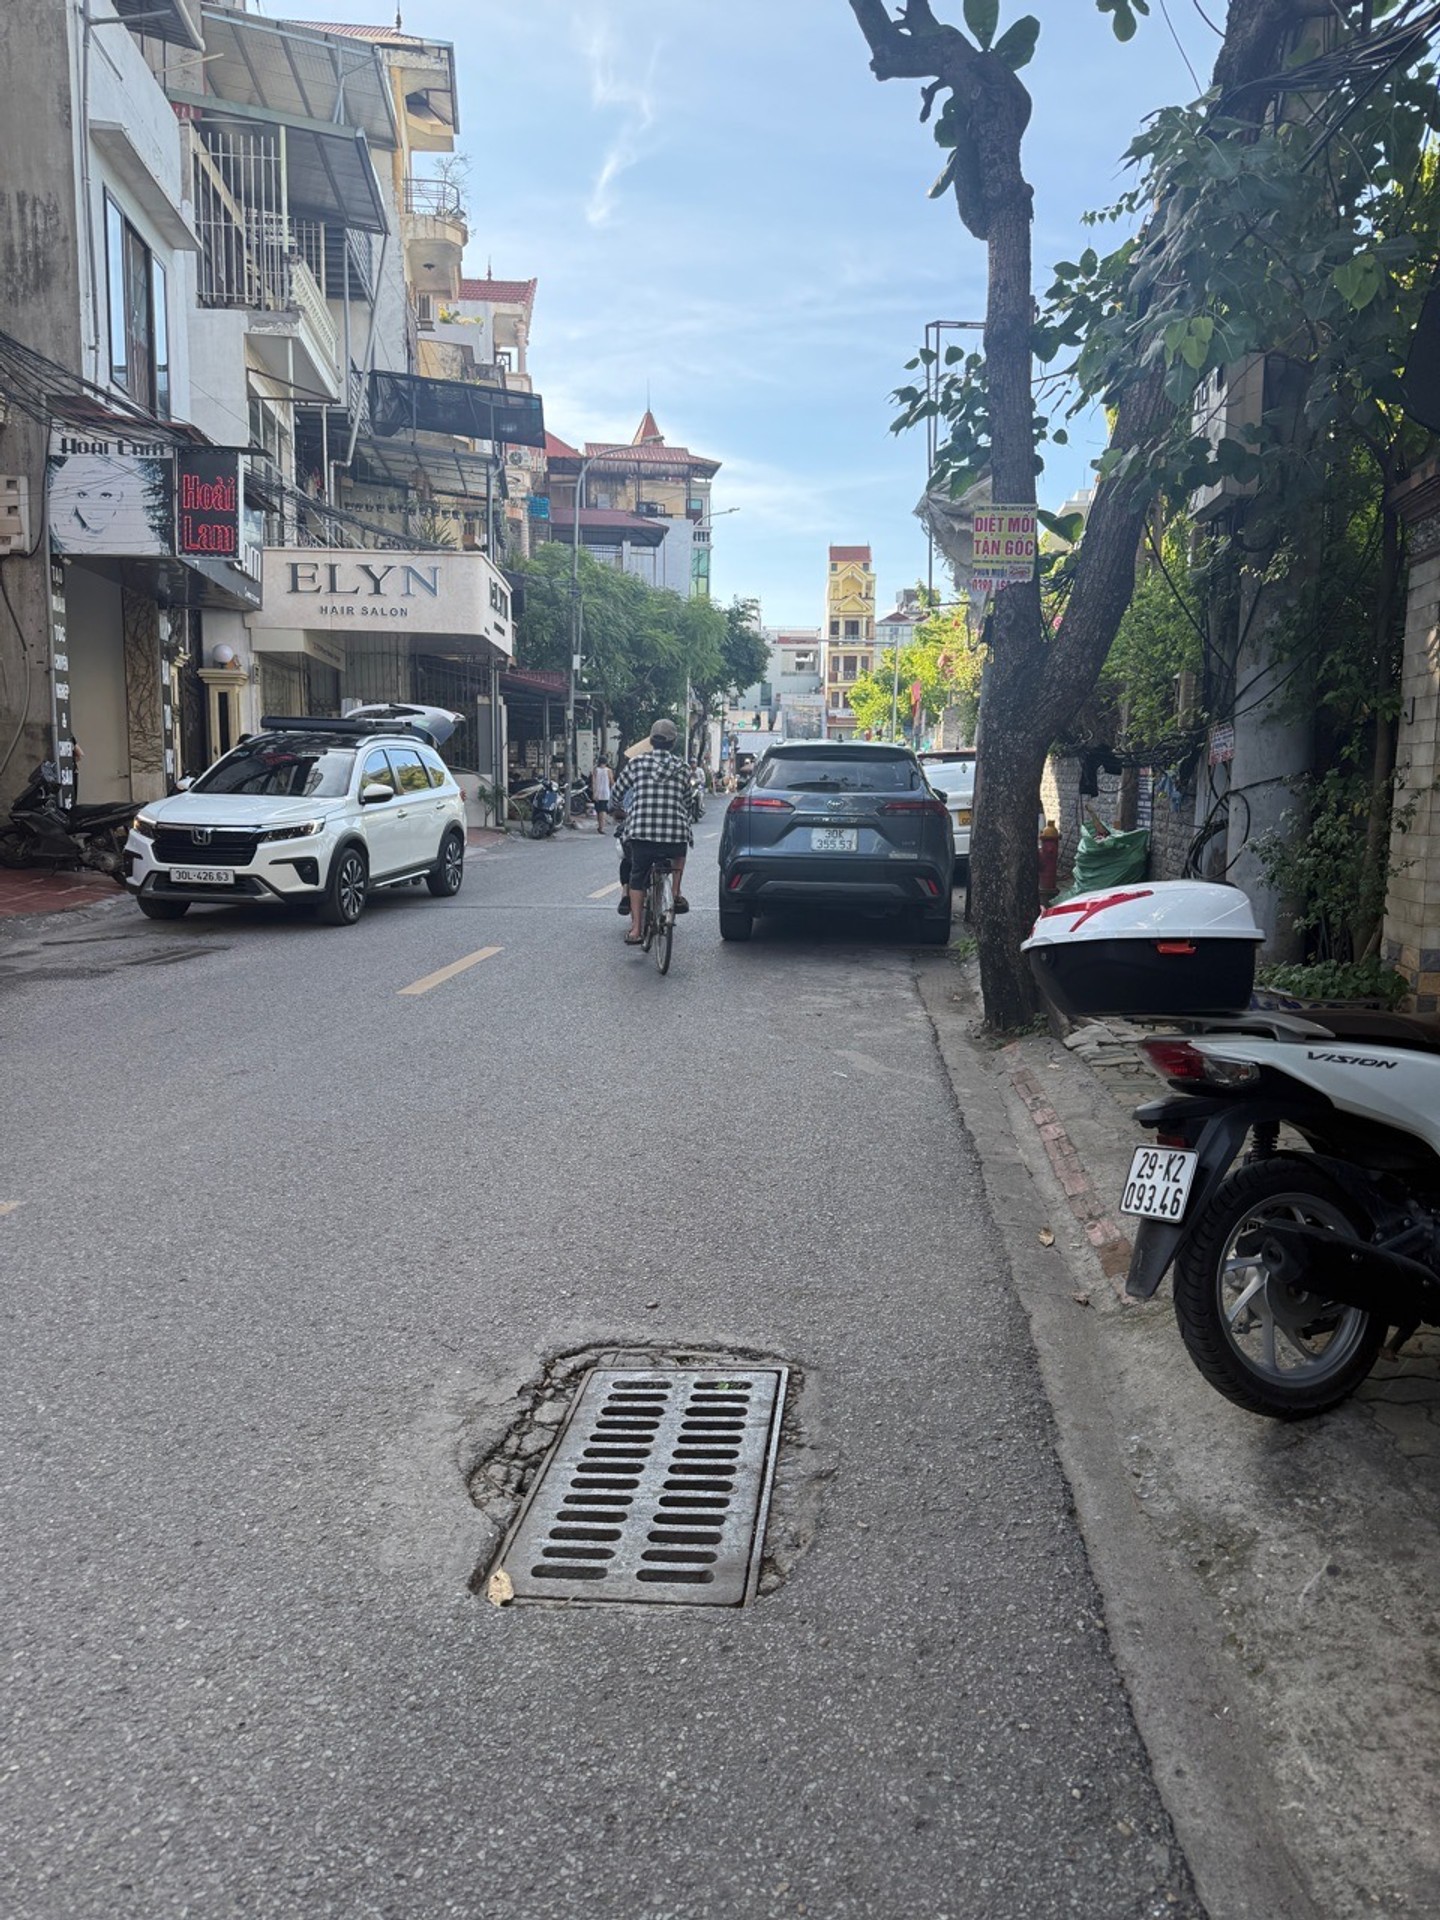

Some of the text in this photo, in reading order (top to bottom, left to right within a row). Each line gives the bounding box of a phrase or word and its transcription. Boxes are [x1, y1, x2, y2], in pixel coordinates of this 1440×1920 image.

[182, 474, 236, 511] Hoài
[183, 515, 235, 552] Lam
[975, 511, 1035, 536] DIỆT MỐI
[974, 534, 1034, 559] TẬN GỐC
[285, 562, 442, 598] ELYN
[319, 605, 408, 617] HAIR SALON
[824, 829, 844, 839] 30K
[1307, 1051, 1398, 1069] VISION
[1136, 1151, 1186, 1183] 29-K2
[1124, 1181, 1183, 1216] 093.46
